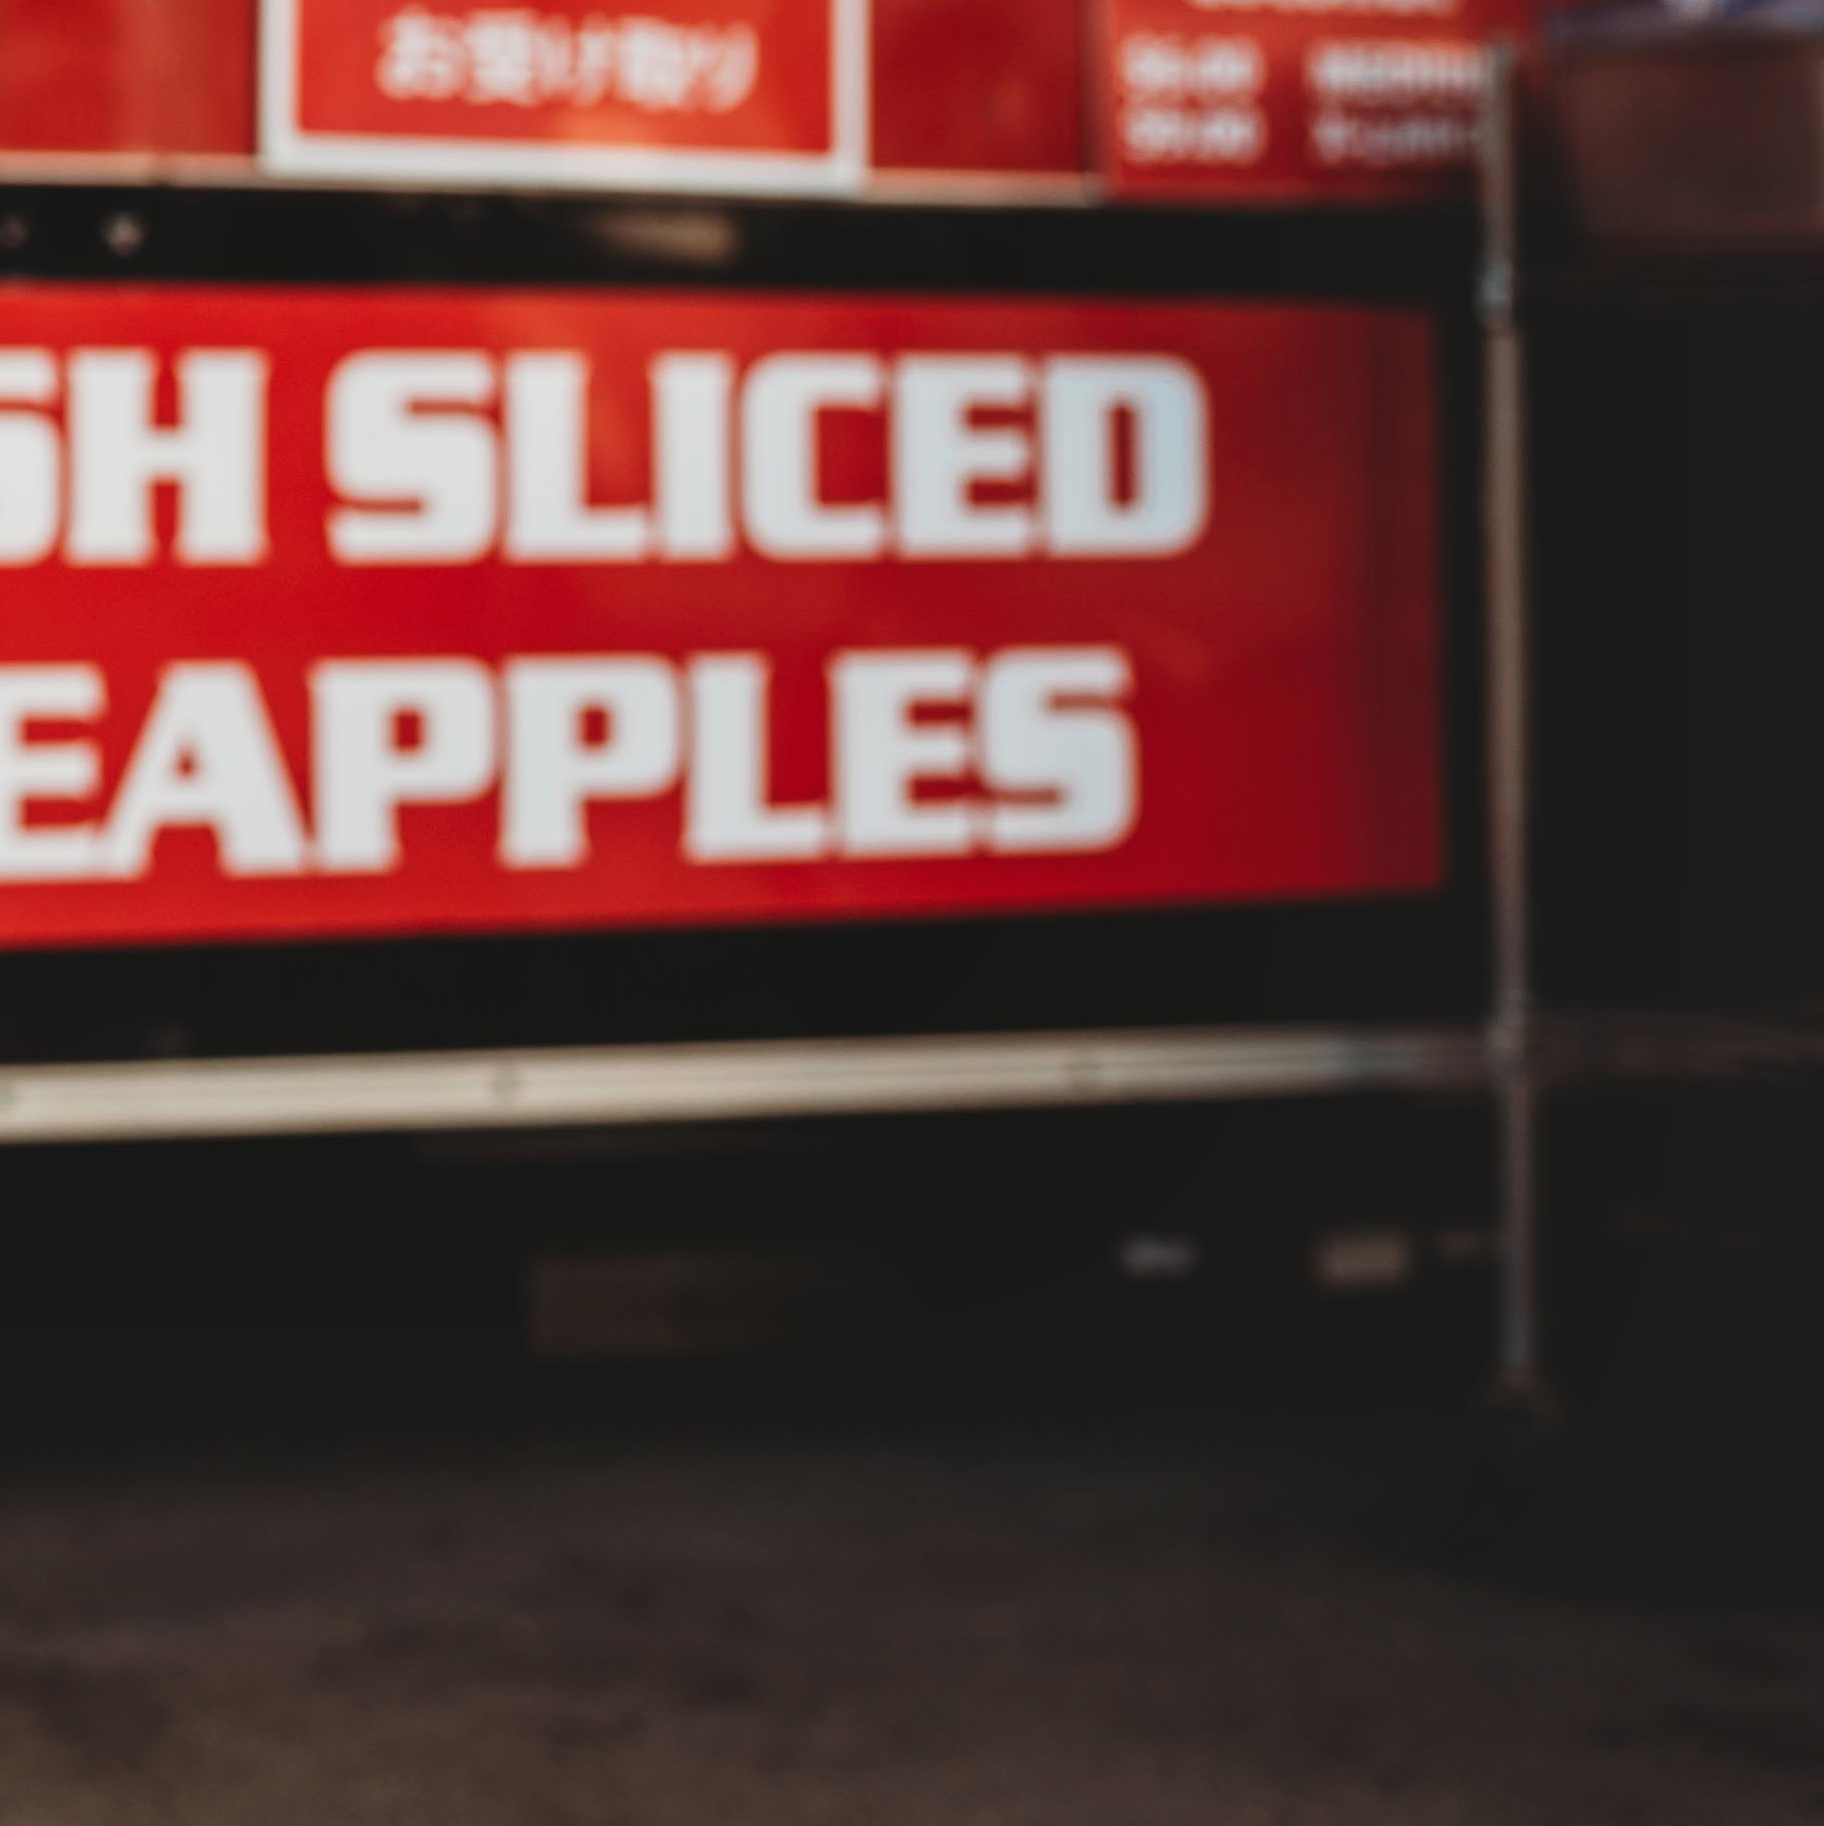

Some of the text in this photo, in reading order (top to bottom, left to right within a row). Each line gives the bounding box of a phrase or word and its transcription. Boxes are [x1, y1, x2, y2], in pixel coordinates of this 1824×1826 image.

[376, 6, 758, 113] お受け取り
[324, 348, 1209, 565] SLICED
